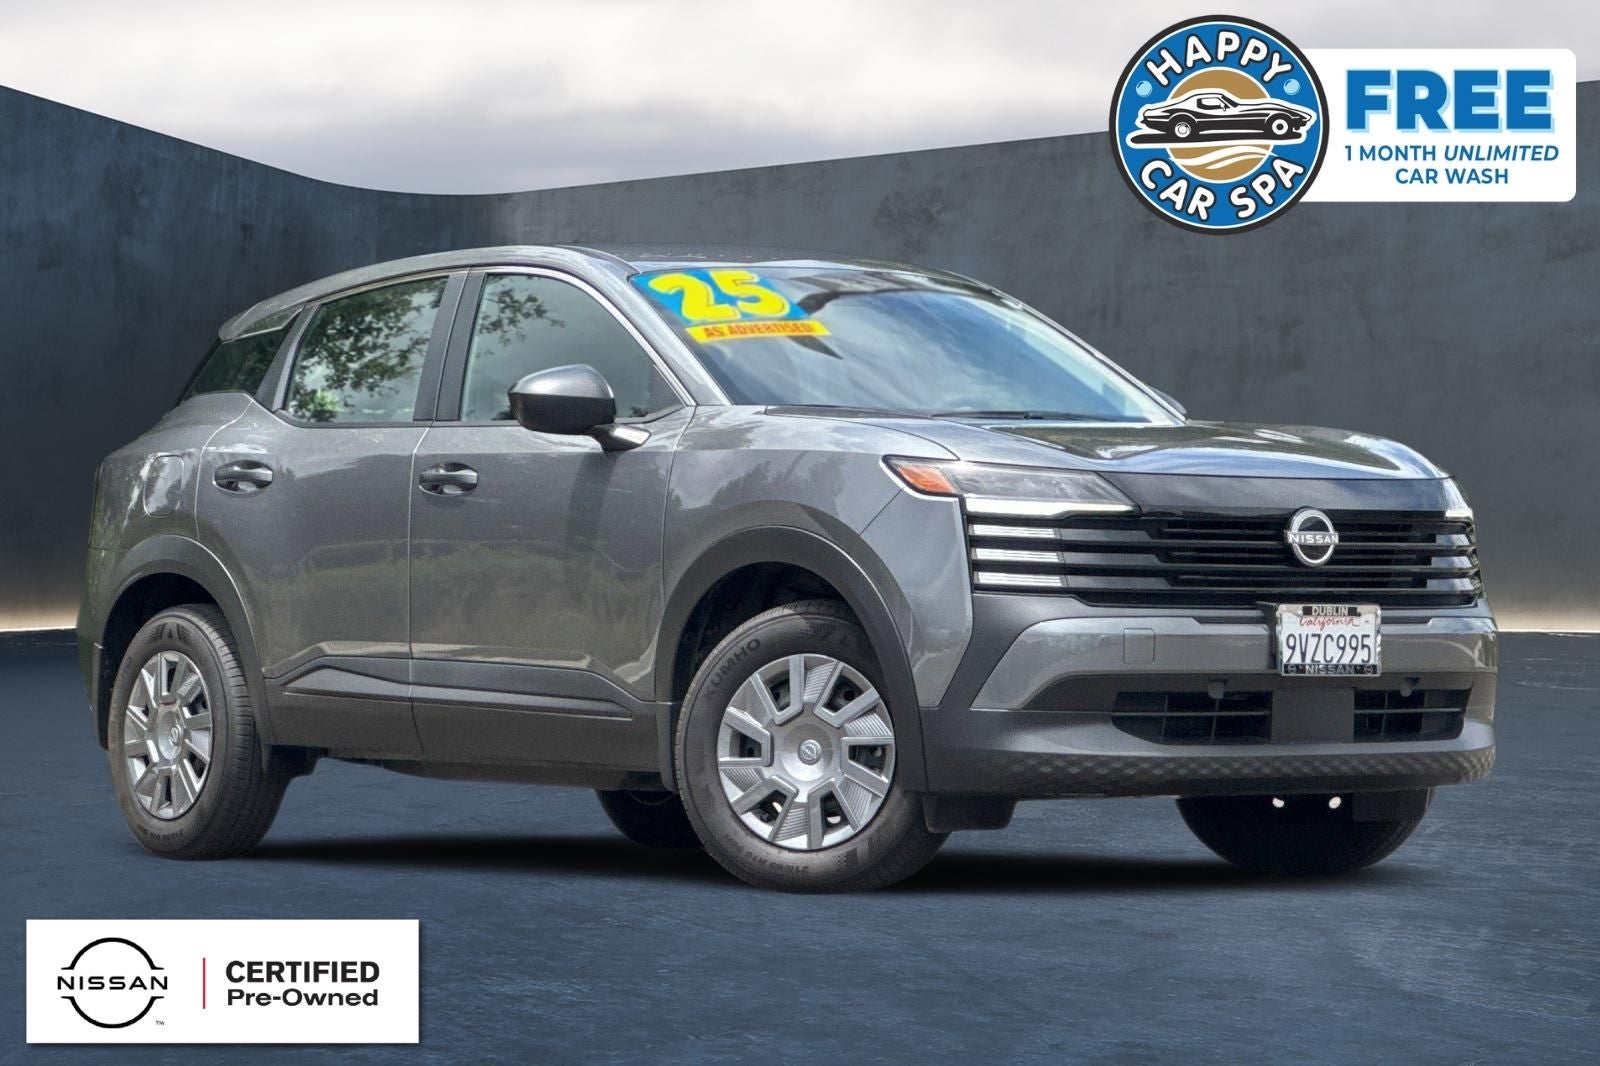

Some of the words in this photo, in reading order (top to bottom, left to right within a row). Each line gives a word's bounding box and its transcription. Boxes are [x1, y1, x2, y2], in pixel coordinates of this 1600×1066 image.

[648, 269, 791, 321] 25
[704, 327, 725, 338] AS
[727, 322, 815, 337] ADVERTISED
[1288, 532, 1339, 544] NISSAN
[1311, 606, 1349, 616] DUBLIN
[1299, 616, 1360, 631] California
[1285, 633, 1371, 664] 9VZC995
[704, 637, 762, 702] KUMHO
[1306, 664, 1355, 674] NISSAN
